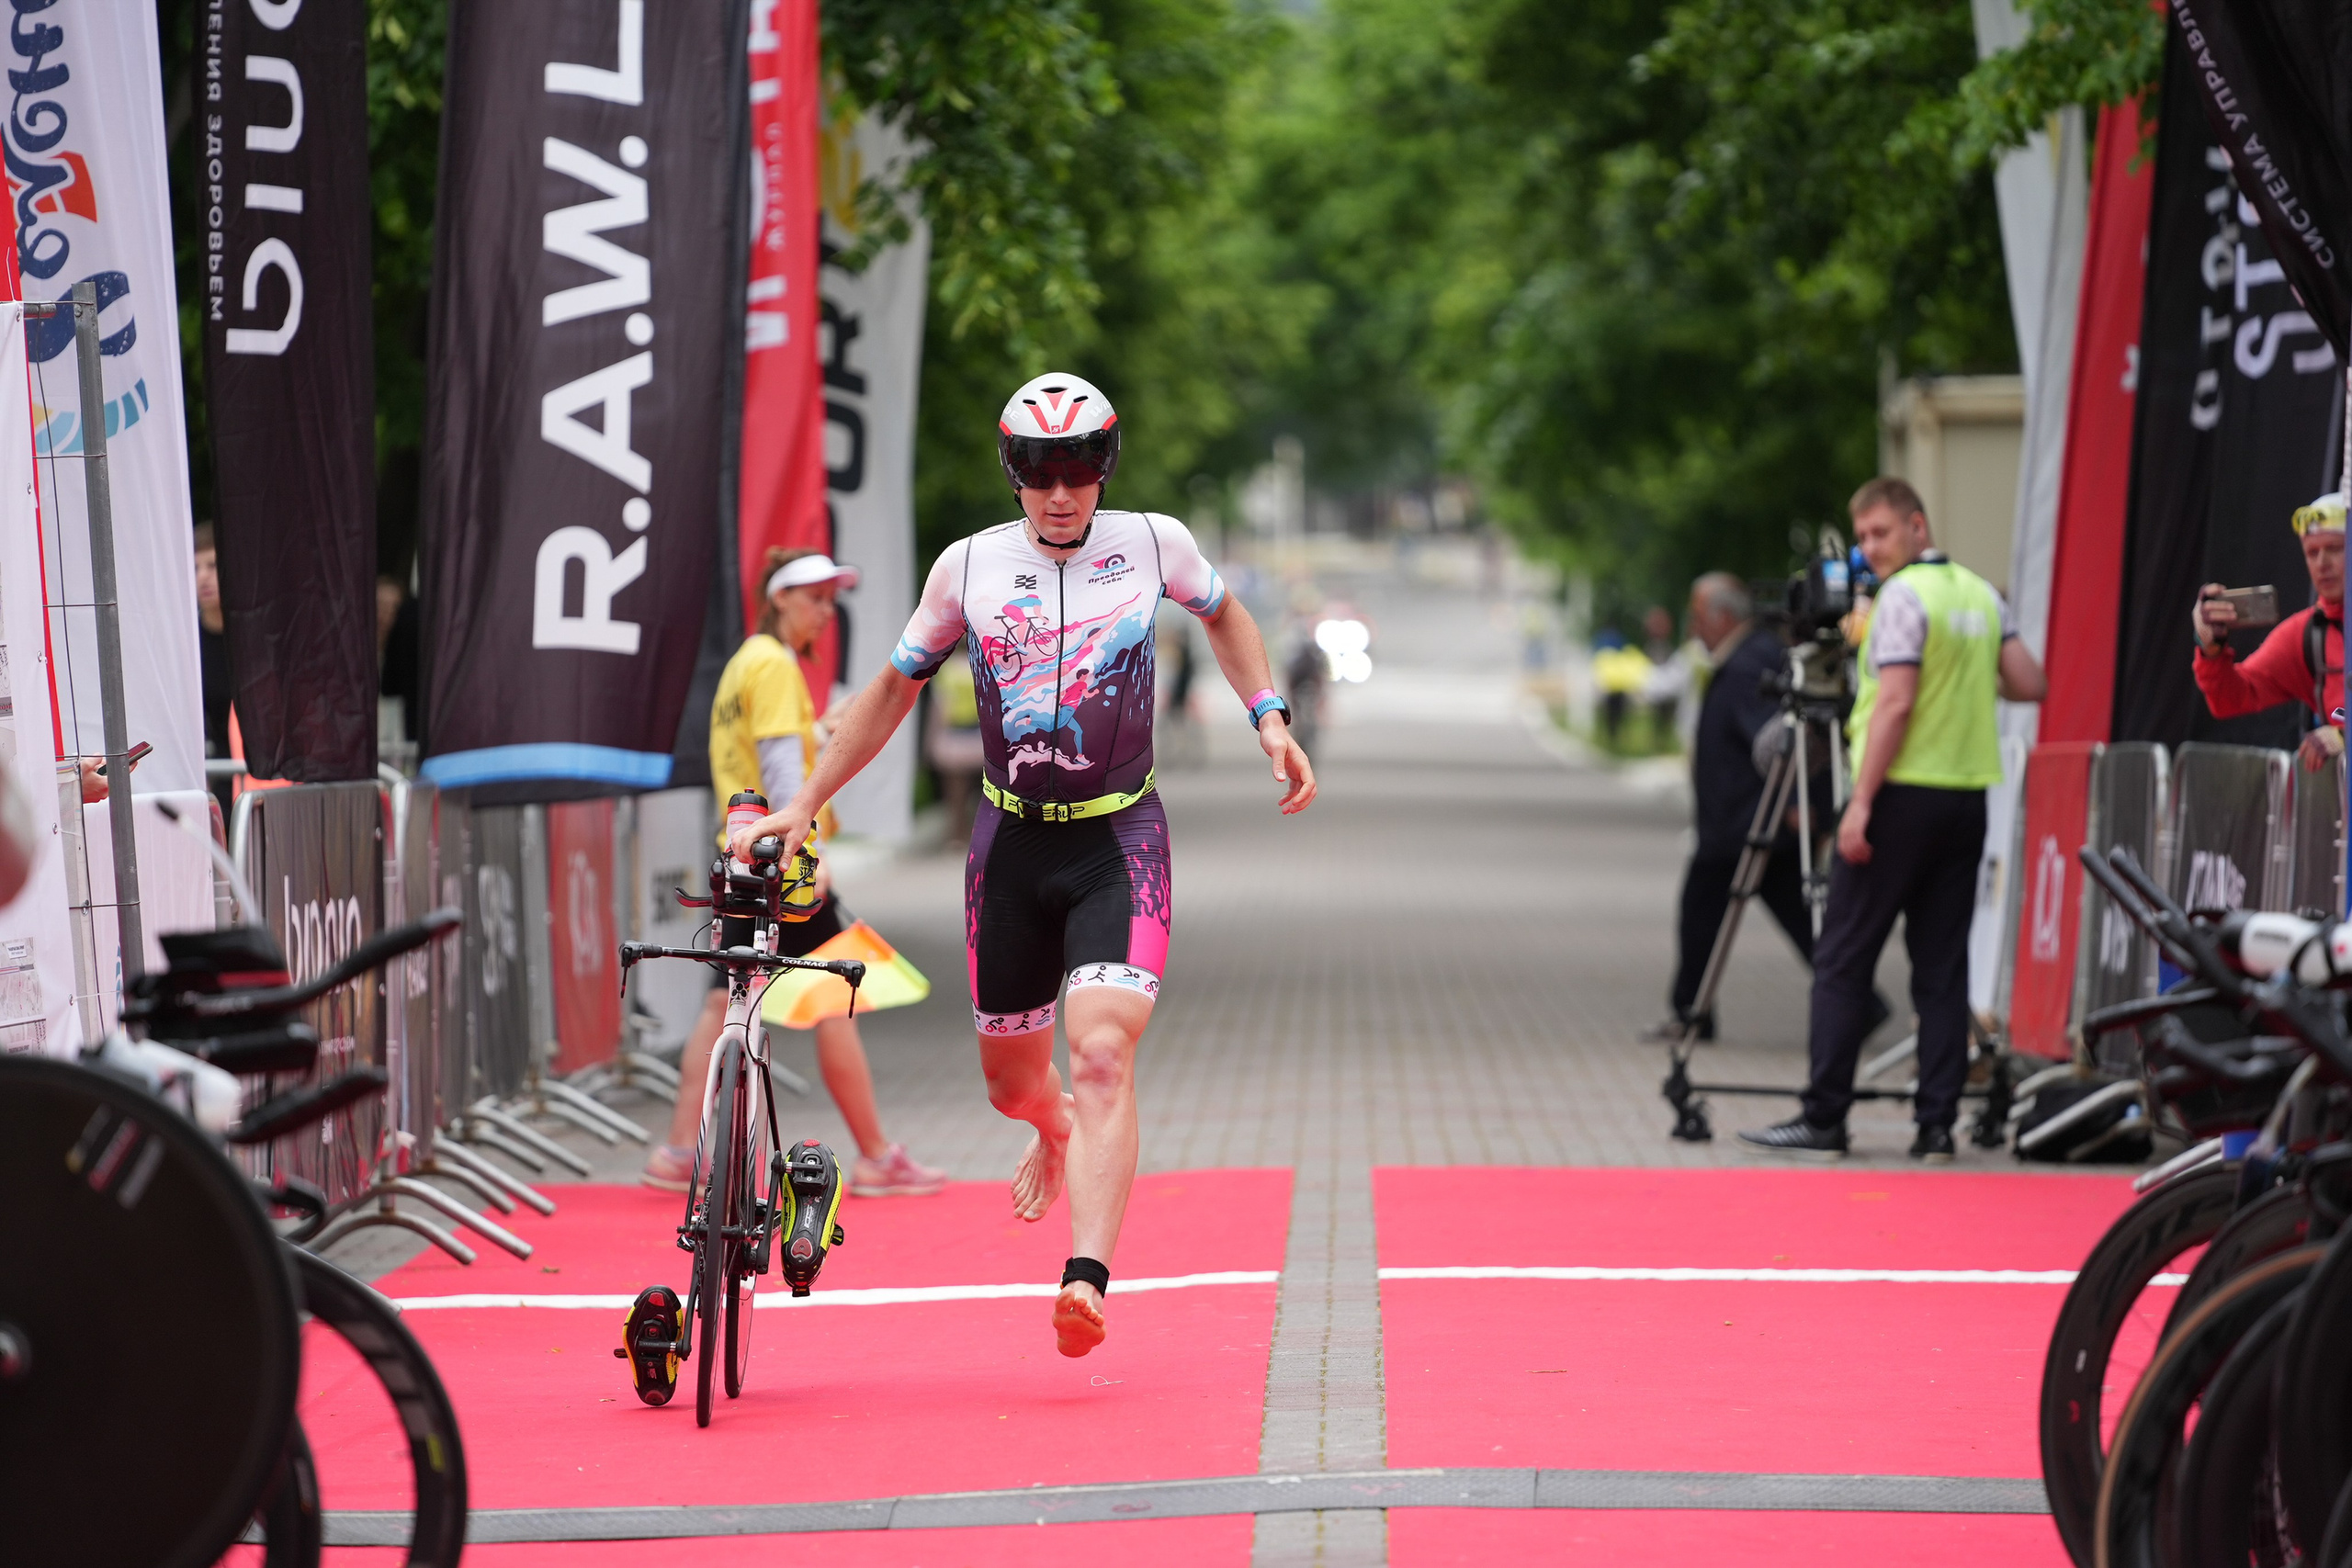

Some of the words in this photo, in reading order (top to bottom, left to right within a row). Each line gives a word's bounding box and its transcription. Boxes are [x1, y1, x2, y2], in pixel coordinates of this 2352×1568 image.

[206, 114, 223, 321] ЗДОРОВЬЕМ
[2243, 131, 2335, 269] СИСТЕМА
[1088, 565, 1136, 584] Преодолей
